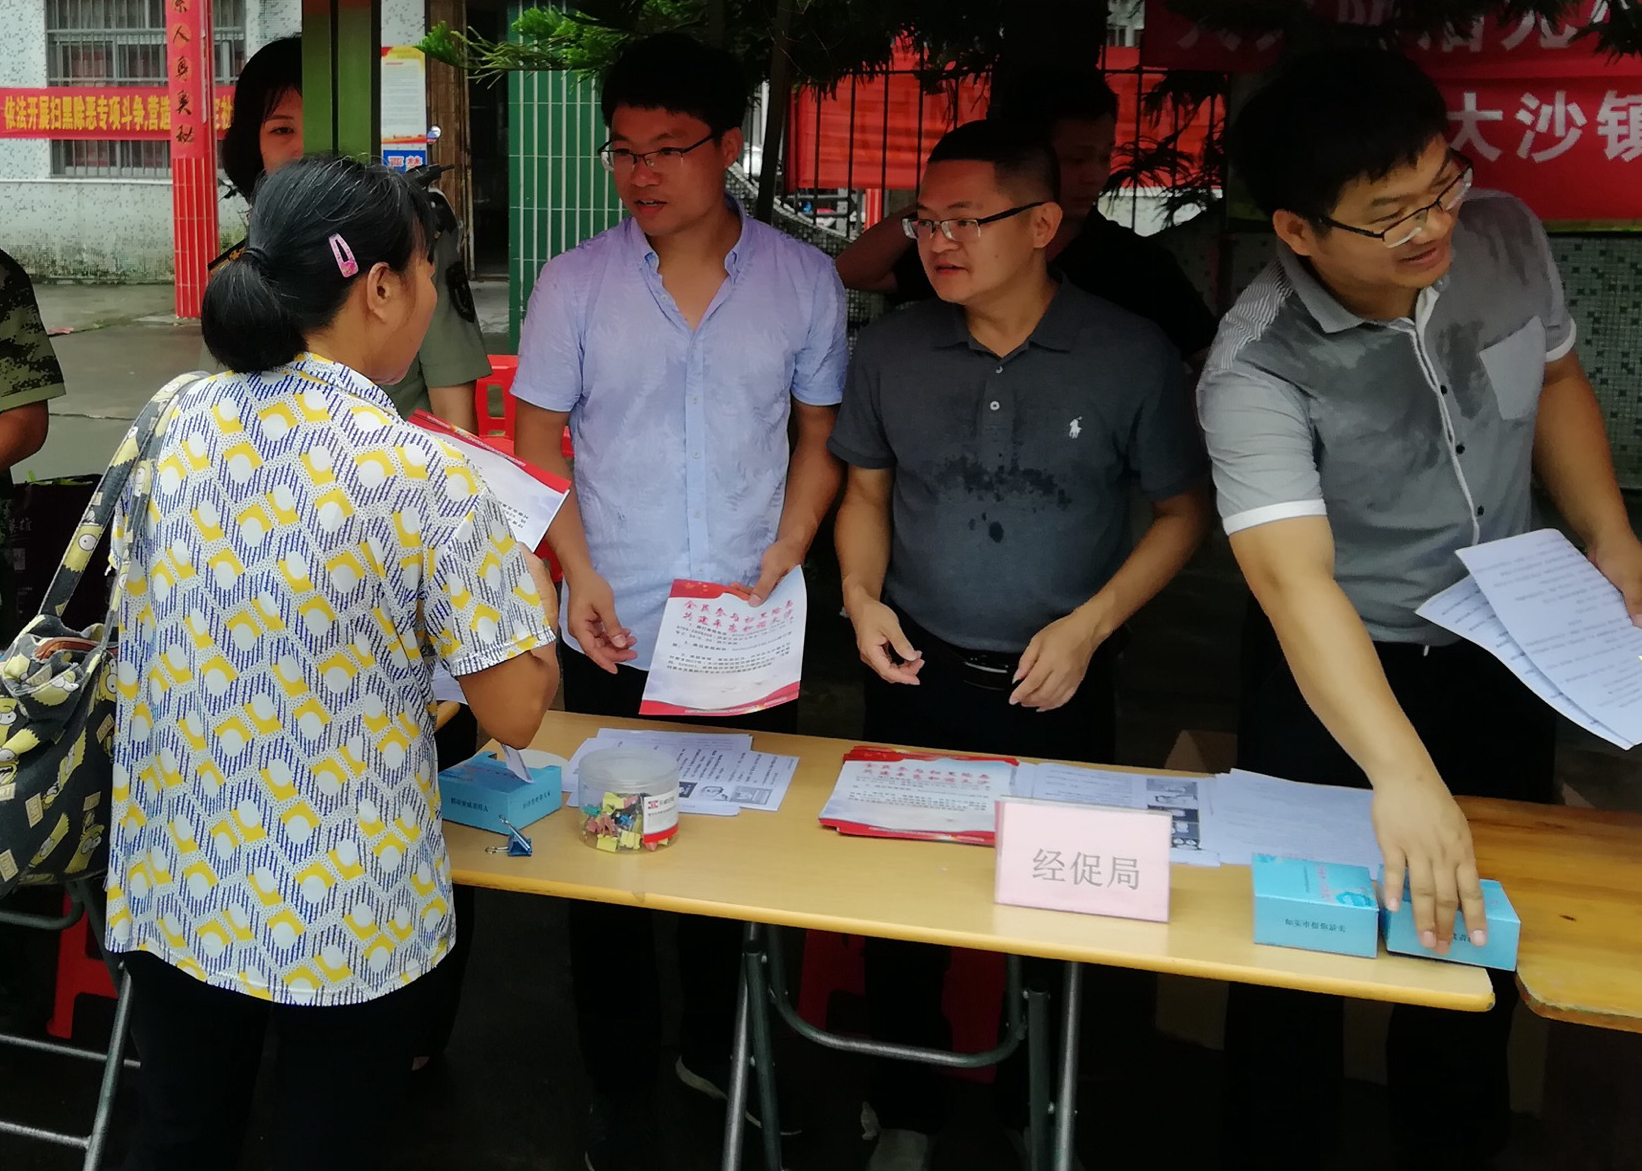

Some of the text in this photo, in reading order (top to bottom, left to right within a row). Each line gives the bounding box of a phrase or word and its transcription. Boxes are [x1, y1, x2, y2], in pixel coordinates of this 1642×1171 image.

[1446, 90, 1642, 163] 大沙镇
[1032, 848, 1140, 891] 经促局
